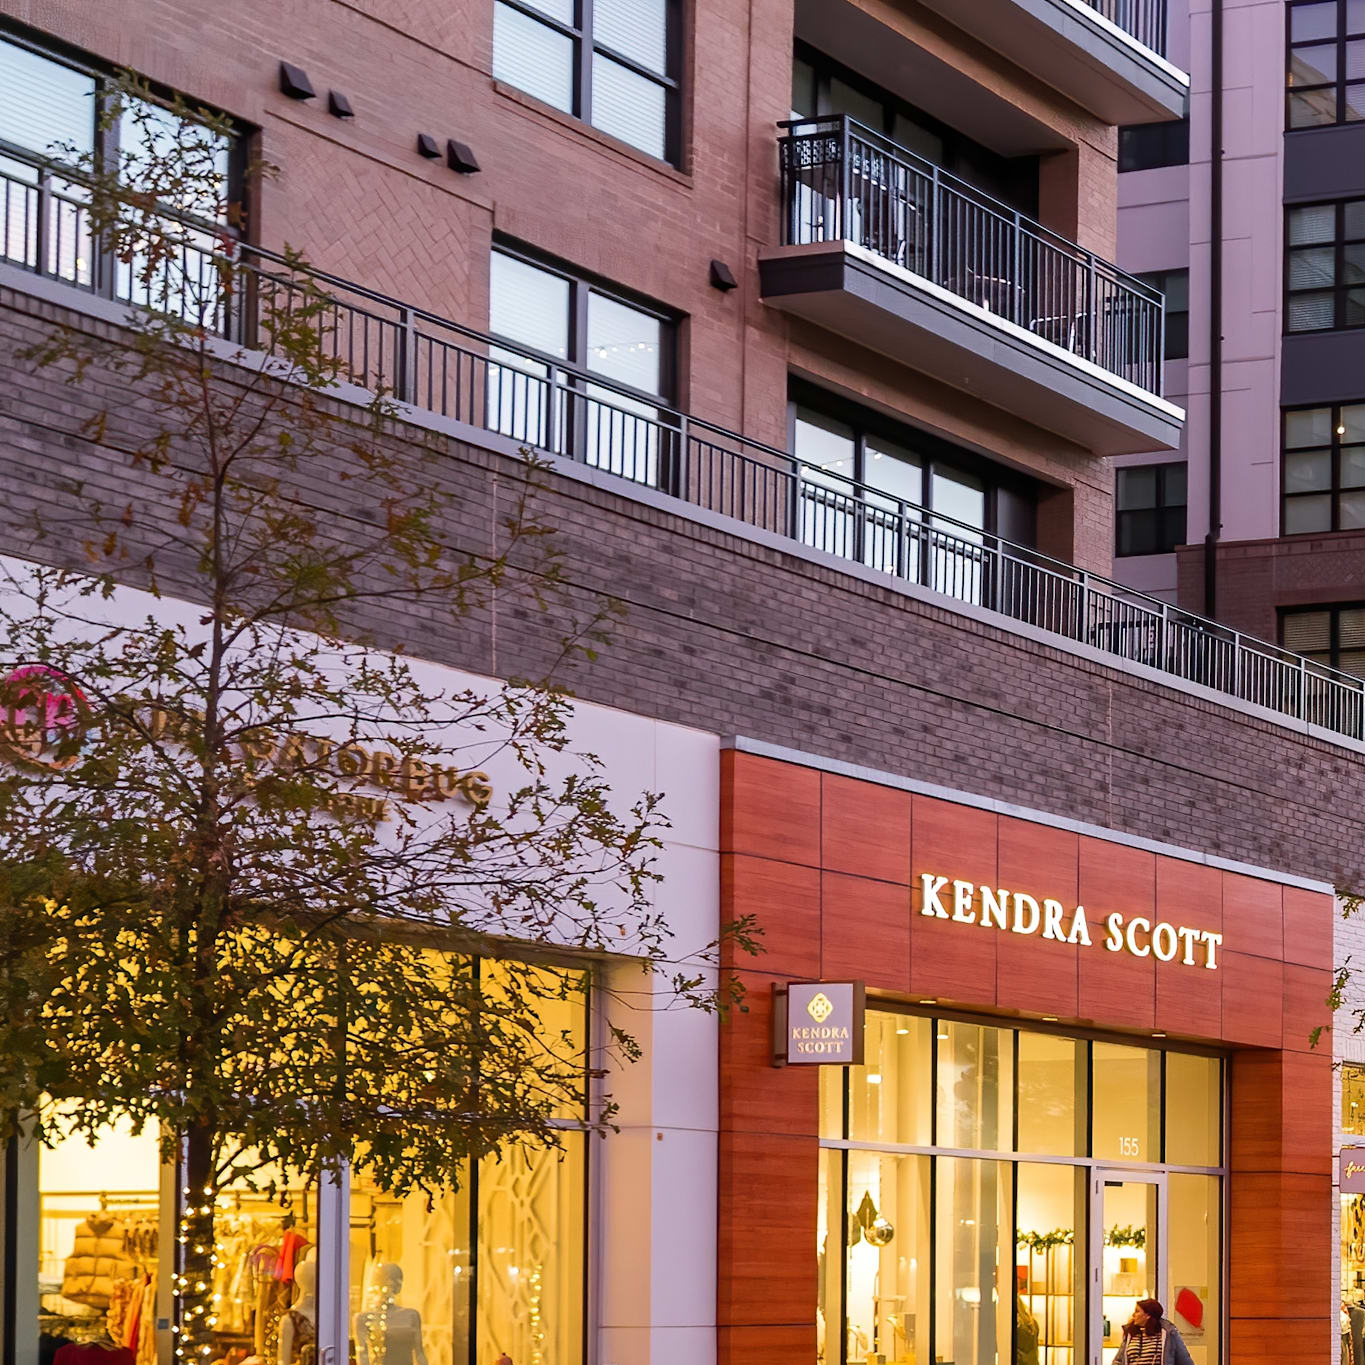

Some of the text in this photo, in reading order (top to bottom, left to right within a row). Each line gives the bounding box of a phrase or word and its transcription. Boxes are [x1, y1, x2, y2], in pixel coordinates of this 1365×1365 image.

[921, 873, 1223, 970] KENDRA SCOTT
[792, 1027, 849, 1039] KENDRA
[797, 1041, 844, 1053] SCOTT
[1119, 1136, 1139, 1156] 155
